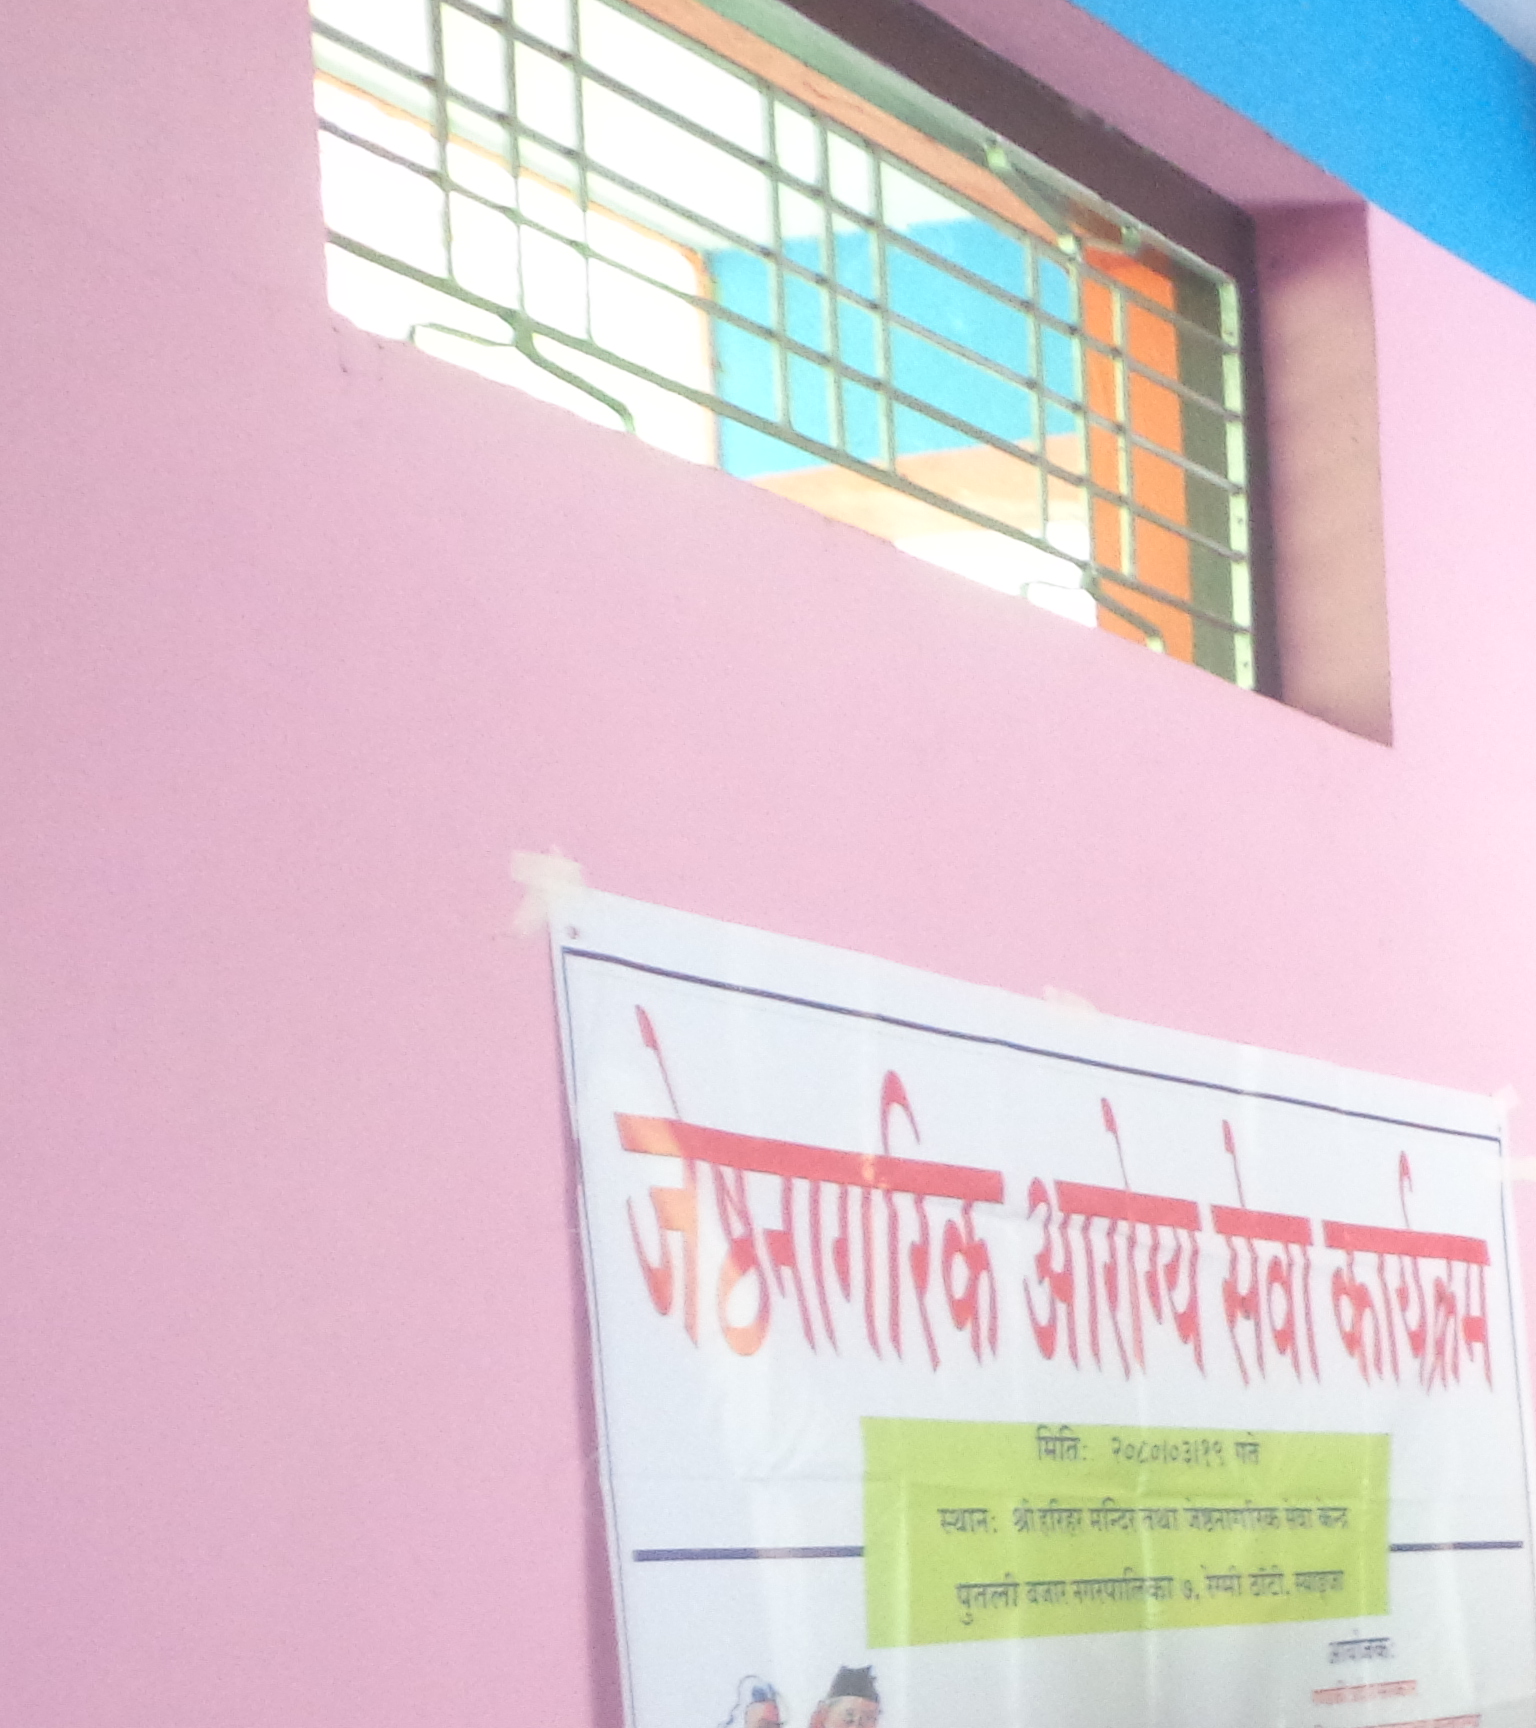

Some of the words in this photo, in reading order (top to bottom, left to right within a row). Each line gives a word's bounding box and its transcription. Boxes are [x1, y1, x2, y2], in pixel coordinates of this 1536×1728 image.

[613, 1003, 1004, 1374] जेष्ठनागरिक
[1023, 1097, 1208, 1382] आरोग्य
[1211, 1119, 1321, 1389] सेवा
[1324, 1150, 1495, 1396] कार्यक्रम
